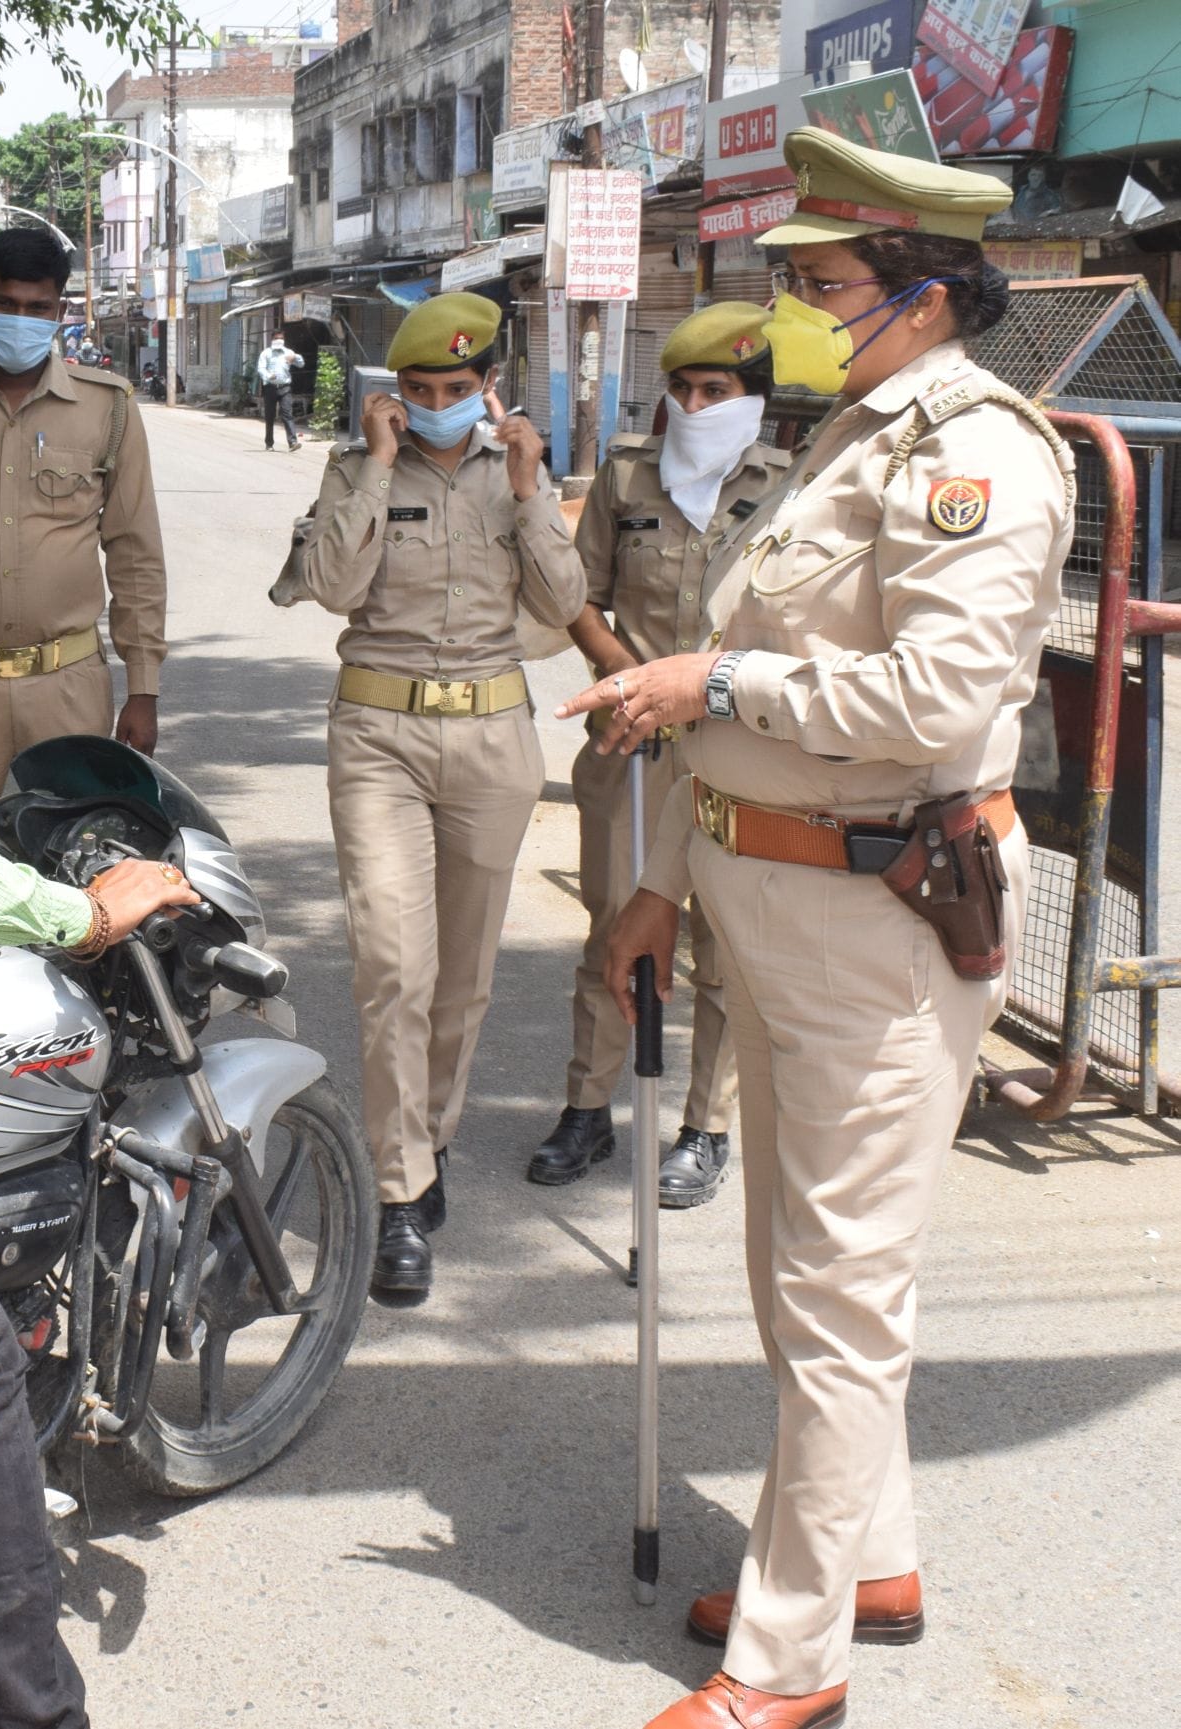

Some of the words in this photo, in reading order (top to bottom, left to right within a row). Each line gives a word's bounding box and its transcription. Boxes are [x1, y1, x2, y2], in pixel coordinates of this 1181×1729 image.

[822, 17, 892, 70] PHILIPS
[722, 114, 773, 150] USHA
[9, 1047, 96, 1079] PRO
[38, 1215, 70, 1229] START
